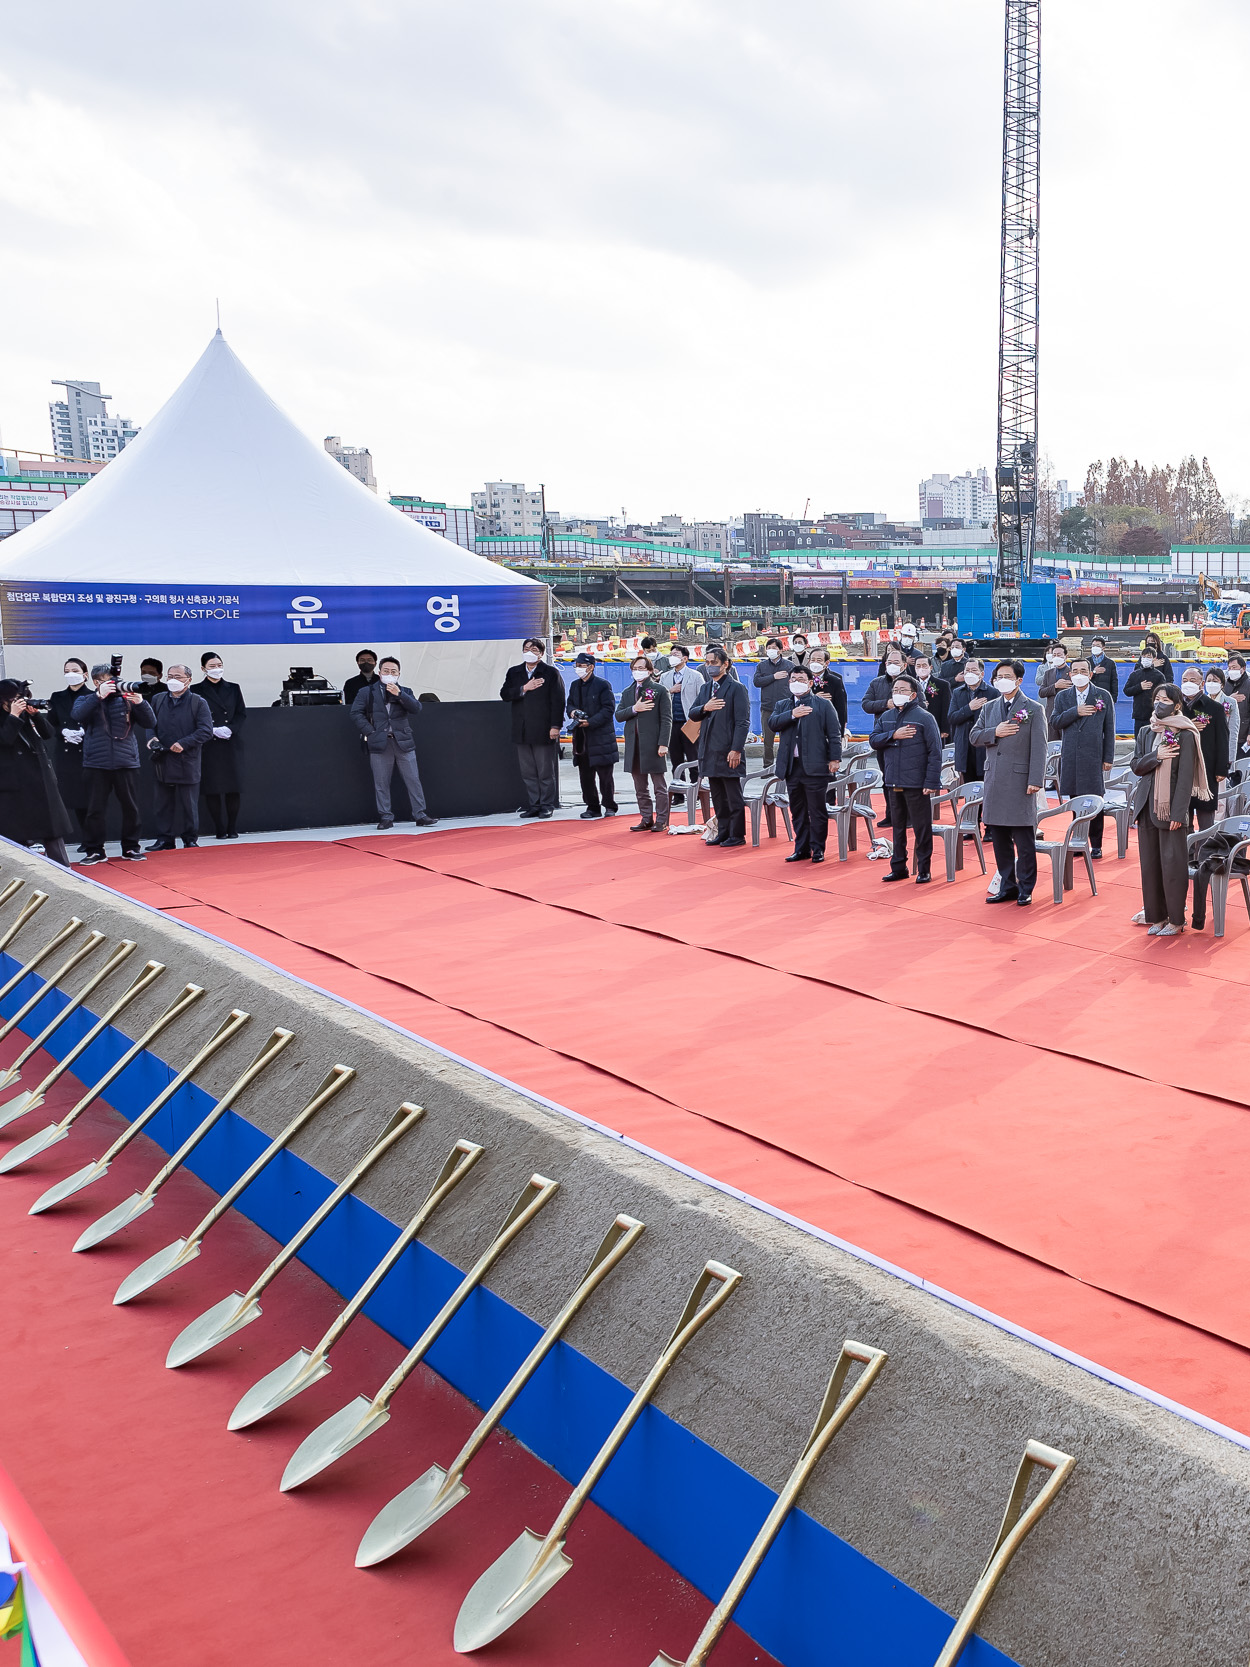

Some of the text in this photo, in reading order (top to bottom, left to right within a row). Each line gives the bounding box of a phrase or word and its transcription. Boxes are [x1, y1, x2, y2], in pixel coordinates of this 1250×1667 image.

[6, 591, 240, 605] 첨단업무 복합단지 조성 및 광진구청 구의회 청사 신축공사 기공식
[173, 608, 240, 619] EASTPOLE
[286, 594, 461, 634] 운 영
